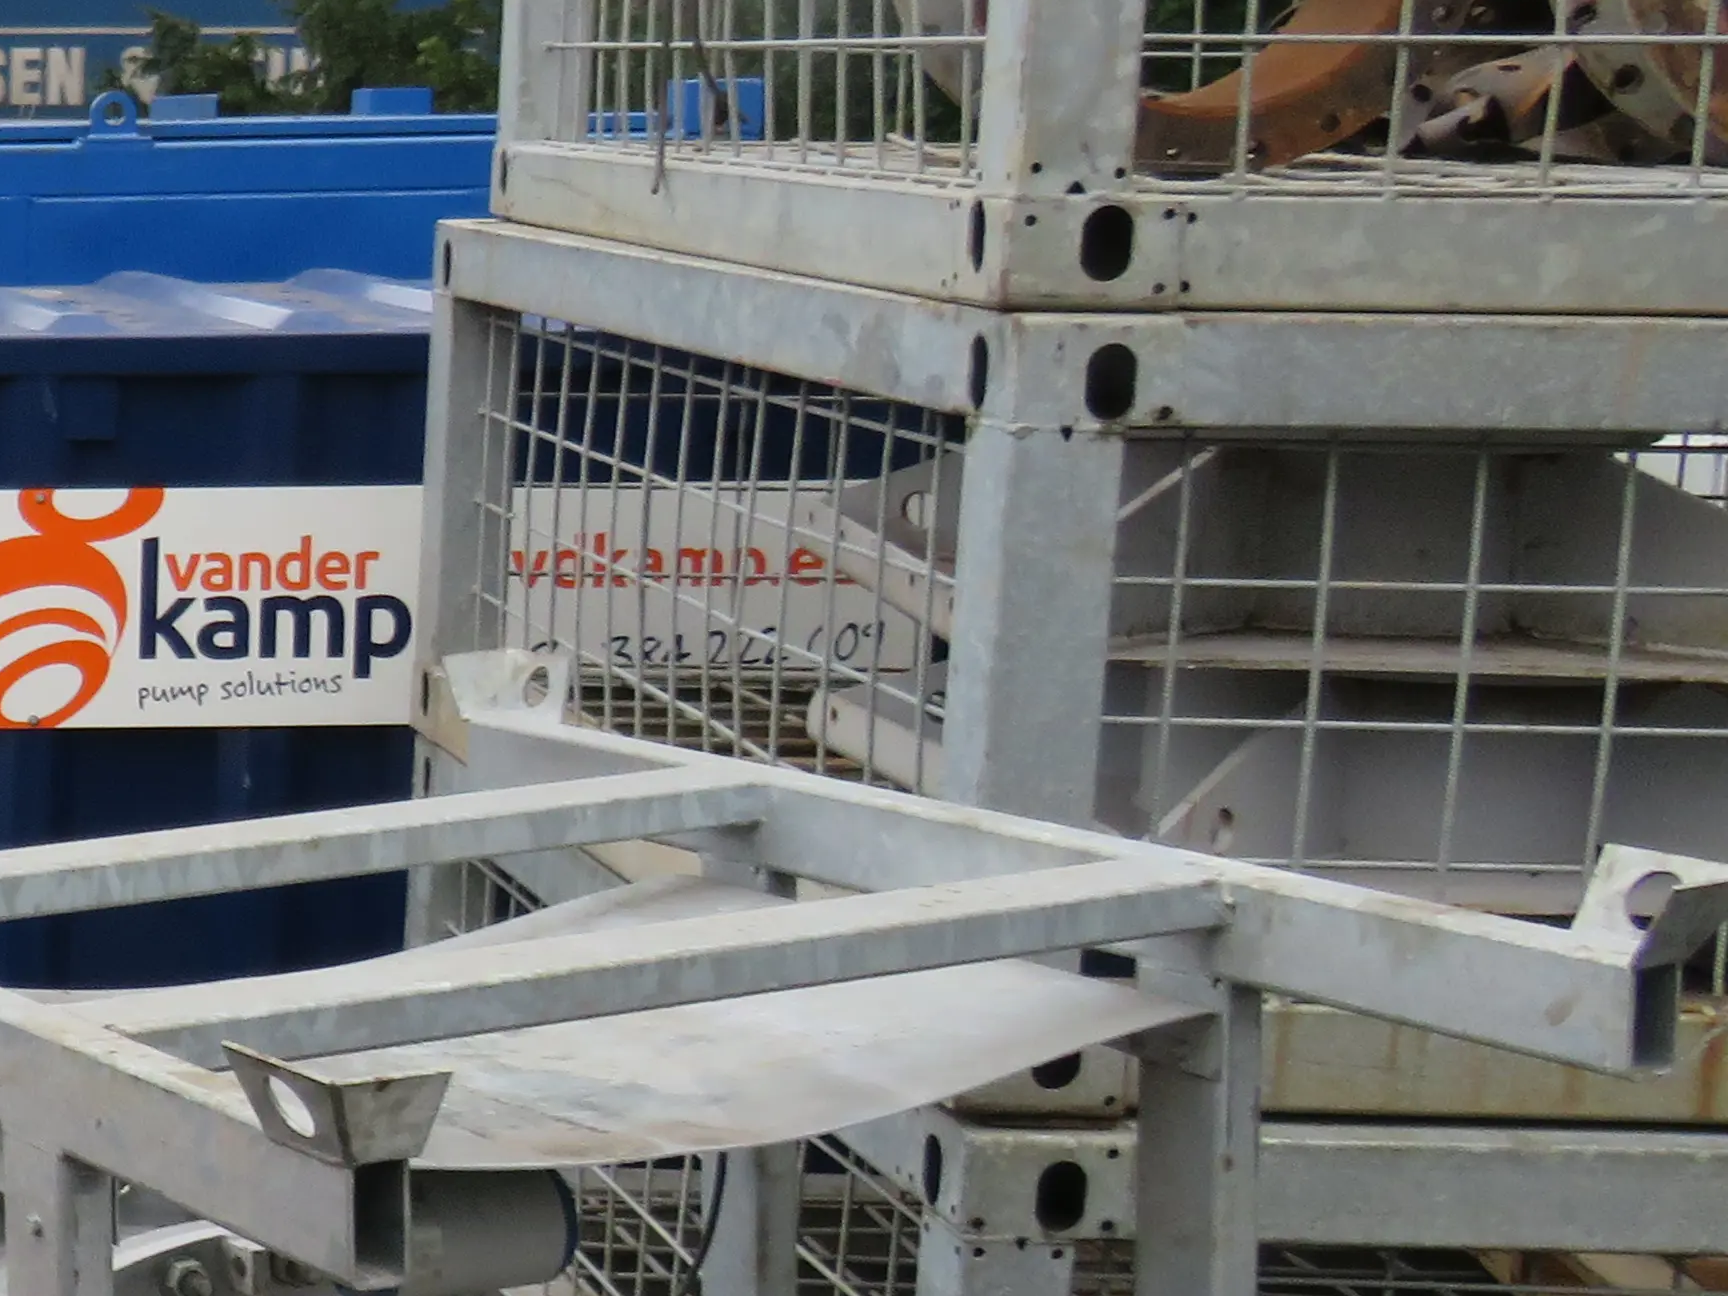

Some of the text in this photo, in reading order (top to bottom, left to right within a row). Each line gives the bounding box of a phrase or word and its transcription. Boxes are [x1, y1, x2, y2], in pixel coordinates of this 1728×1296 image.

[164, 535, 381, 592] vander
[138, 536, 412, 679] kamp
[138, 671, 343, 709] pump solutions
